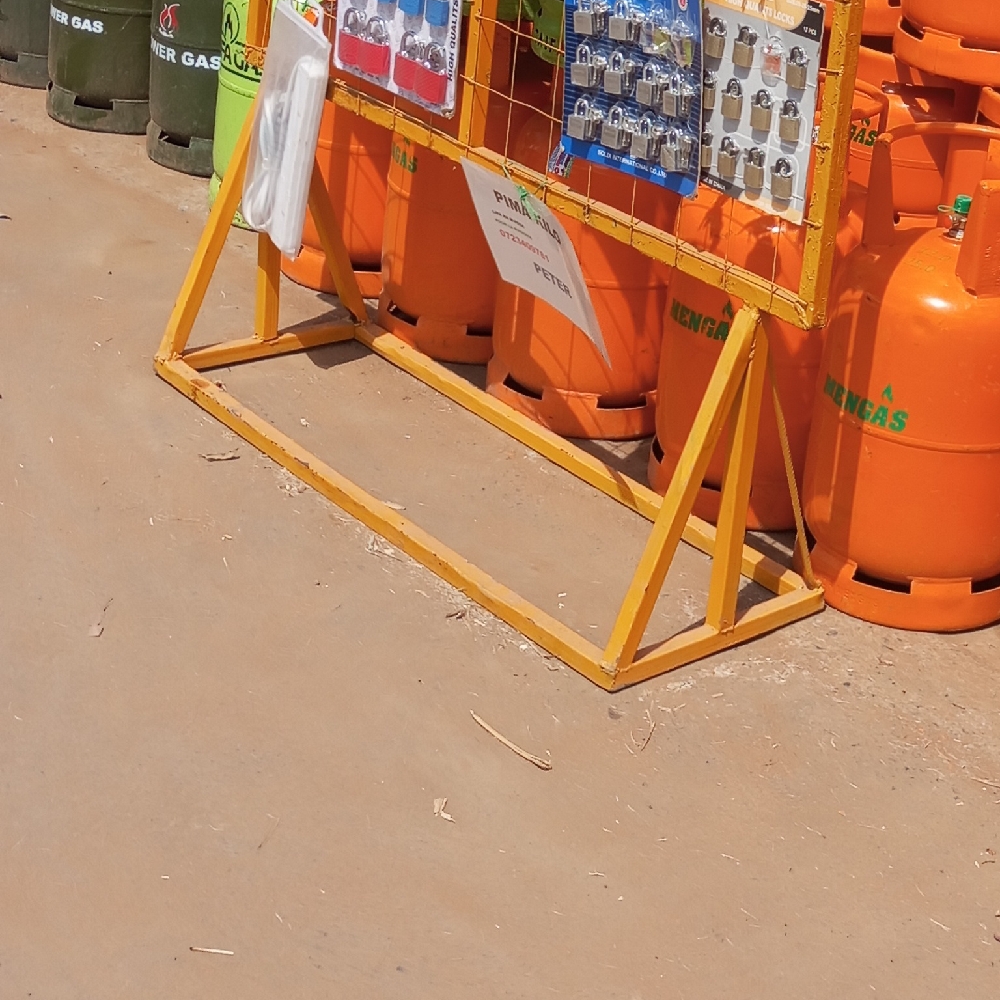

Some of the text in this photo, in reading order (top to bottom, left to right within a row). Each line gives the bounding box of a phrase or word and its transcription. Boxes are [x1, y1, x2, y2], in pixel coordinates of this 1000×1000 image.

[71, 15, 105, 35] GAS
[773, 9, 795, 26] LOCKS
[181, 51, 221, 71] GAS
[493, 189, 532, 220] PIMA
[671, 297, 732, 342] MENGA
[823, 372, 909, 433] MENGAS
